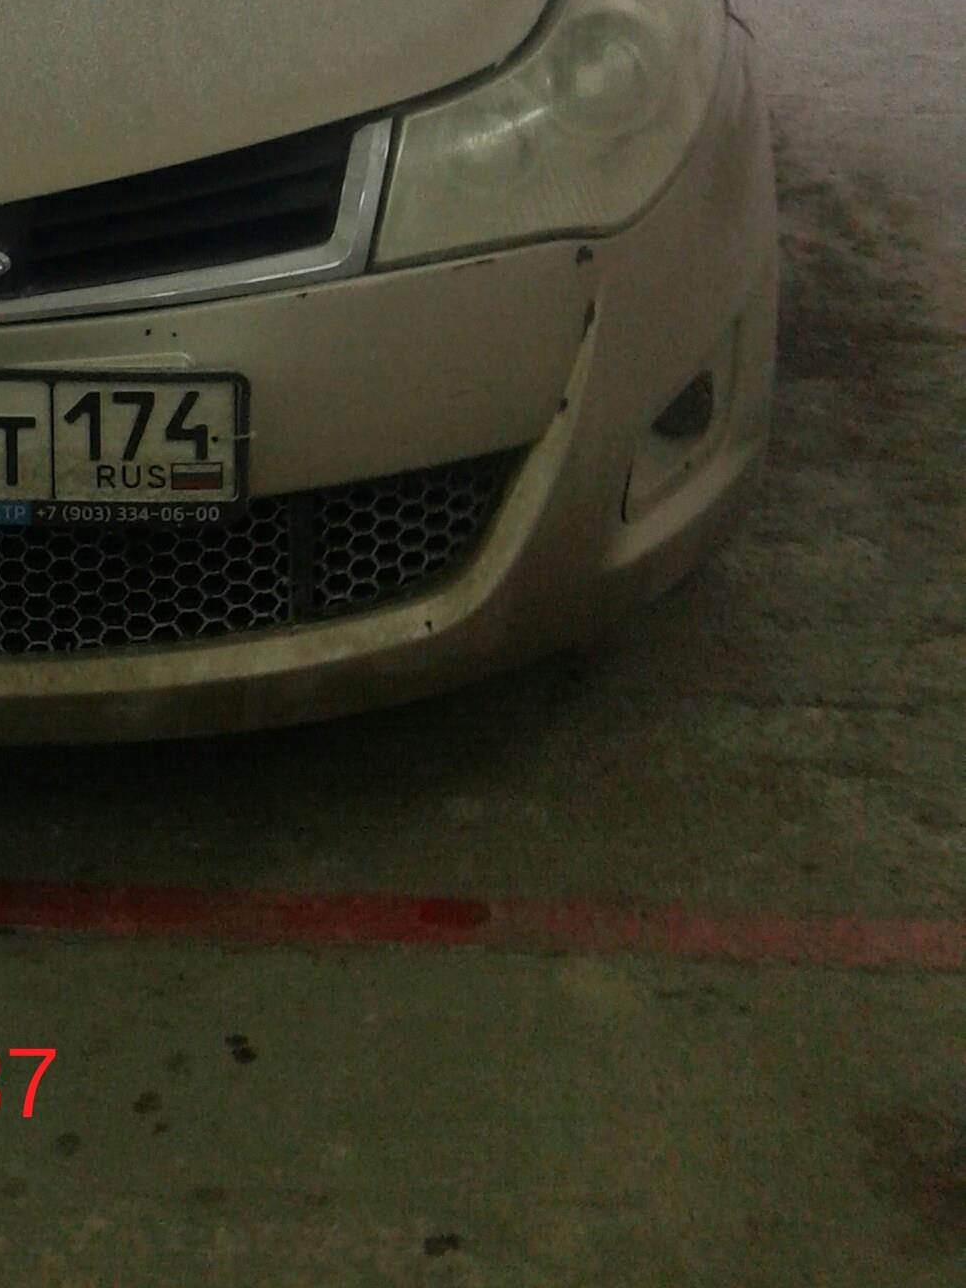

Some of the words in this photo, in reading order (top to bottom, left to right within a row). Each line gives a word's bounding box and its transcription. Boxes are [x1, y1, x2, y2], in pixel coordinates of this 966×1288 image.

[64, 391, 209, 462] 174
[97, 464, 166, 489] RUS
[36, 505, 55, 521] +7
[62, 505, 111, 523] (903)
[118, 506, 220, 522] 334-06-00
